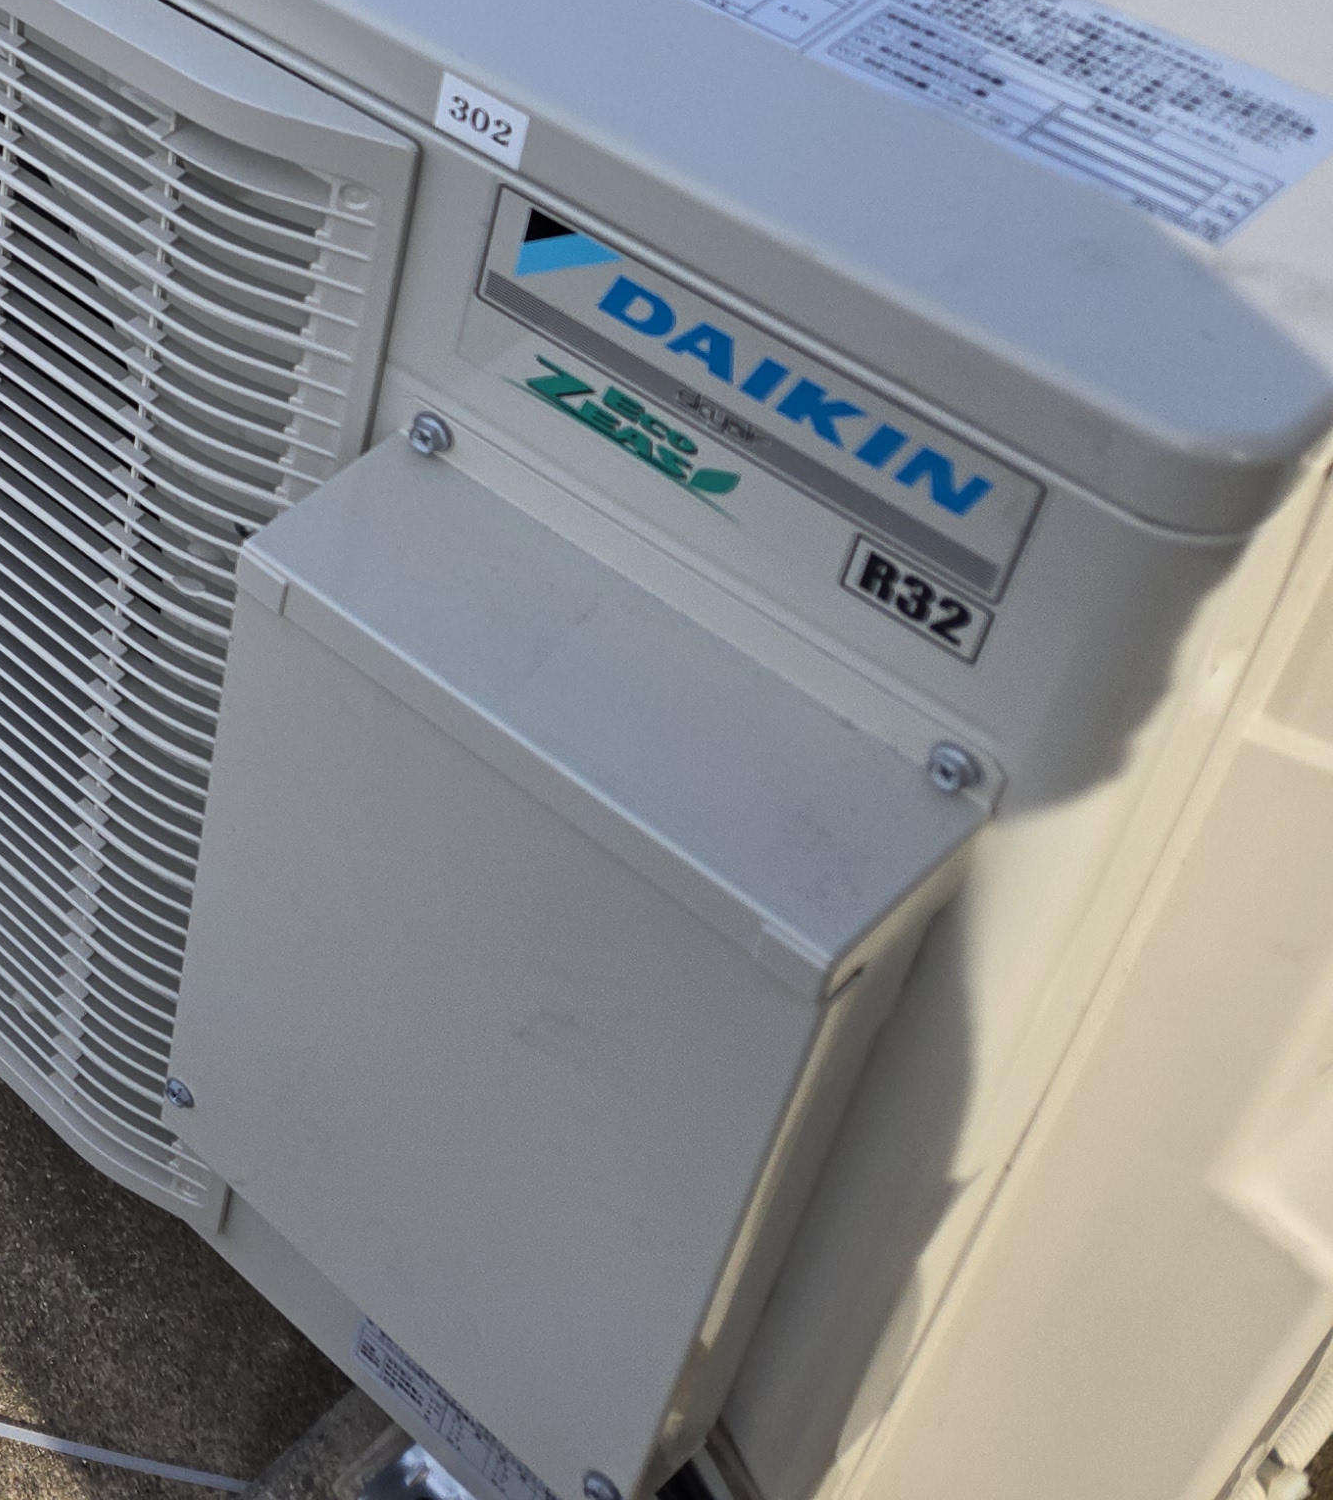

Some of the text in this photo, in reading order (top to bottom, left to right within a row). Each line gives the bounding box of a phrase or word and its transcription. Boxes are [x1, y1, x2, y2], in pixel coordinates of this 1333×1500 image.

[448, 93, 515, 149] 302
[596, 274, 994, 517] DAIKIN
[858, 549, 973, 648] R32
